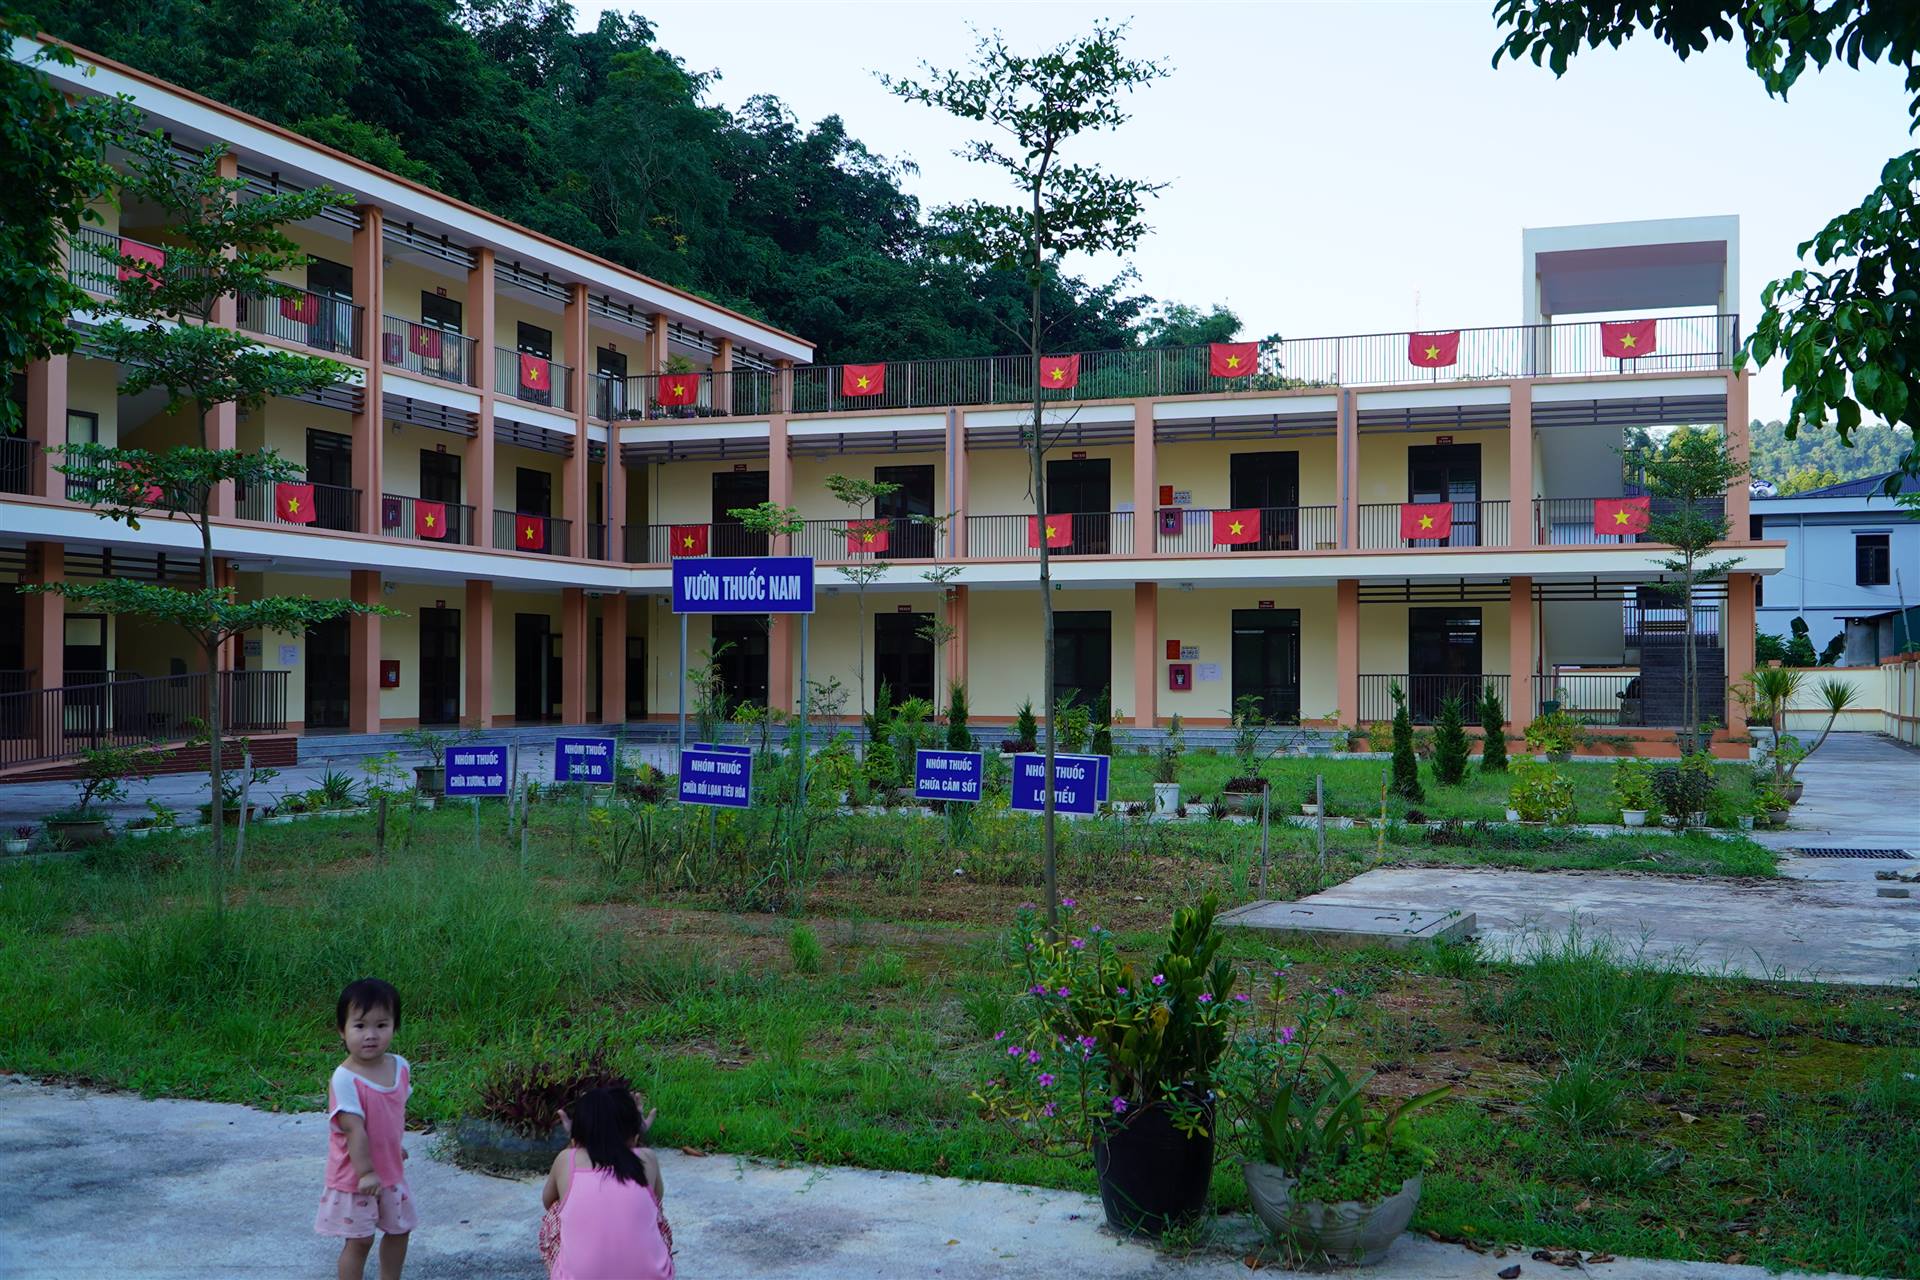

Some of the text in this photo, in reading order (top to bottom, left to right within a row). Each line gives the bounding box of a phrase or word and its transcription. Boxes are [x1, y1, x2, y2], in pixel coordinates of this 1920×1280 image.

[683, 567, 801, 601] VƯỜN THUỐC NAM
[455, 750, 499, 765] NHÓM THUỐC
[564, 742, 607, 756] NHÓM THUỐC
[591, 764, 602, 775] HO
[692, 758, 741, 775] NHÓM THUỐC
[926, 756, 973, 771] NHÓM THUỐC
[1025, 762, 1085, 780] NHÓ THUỐC
[920, 776, 977, 793] CHỮA CẢM SỐT
[1054, 786, 1076, 805] TIỂU
